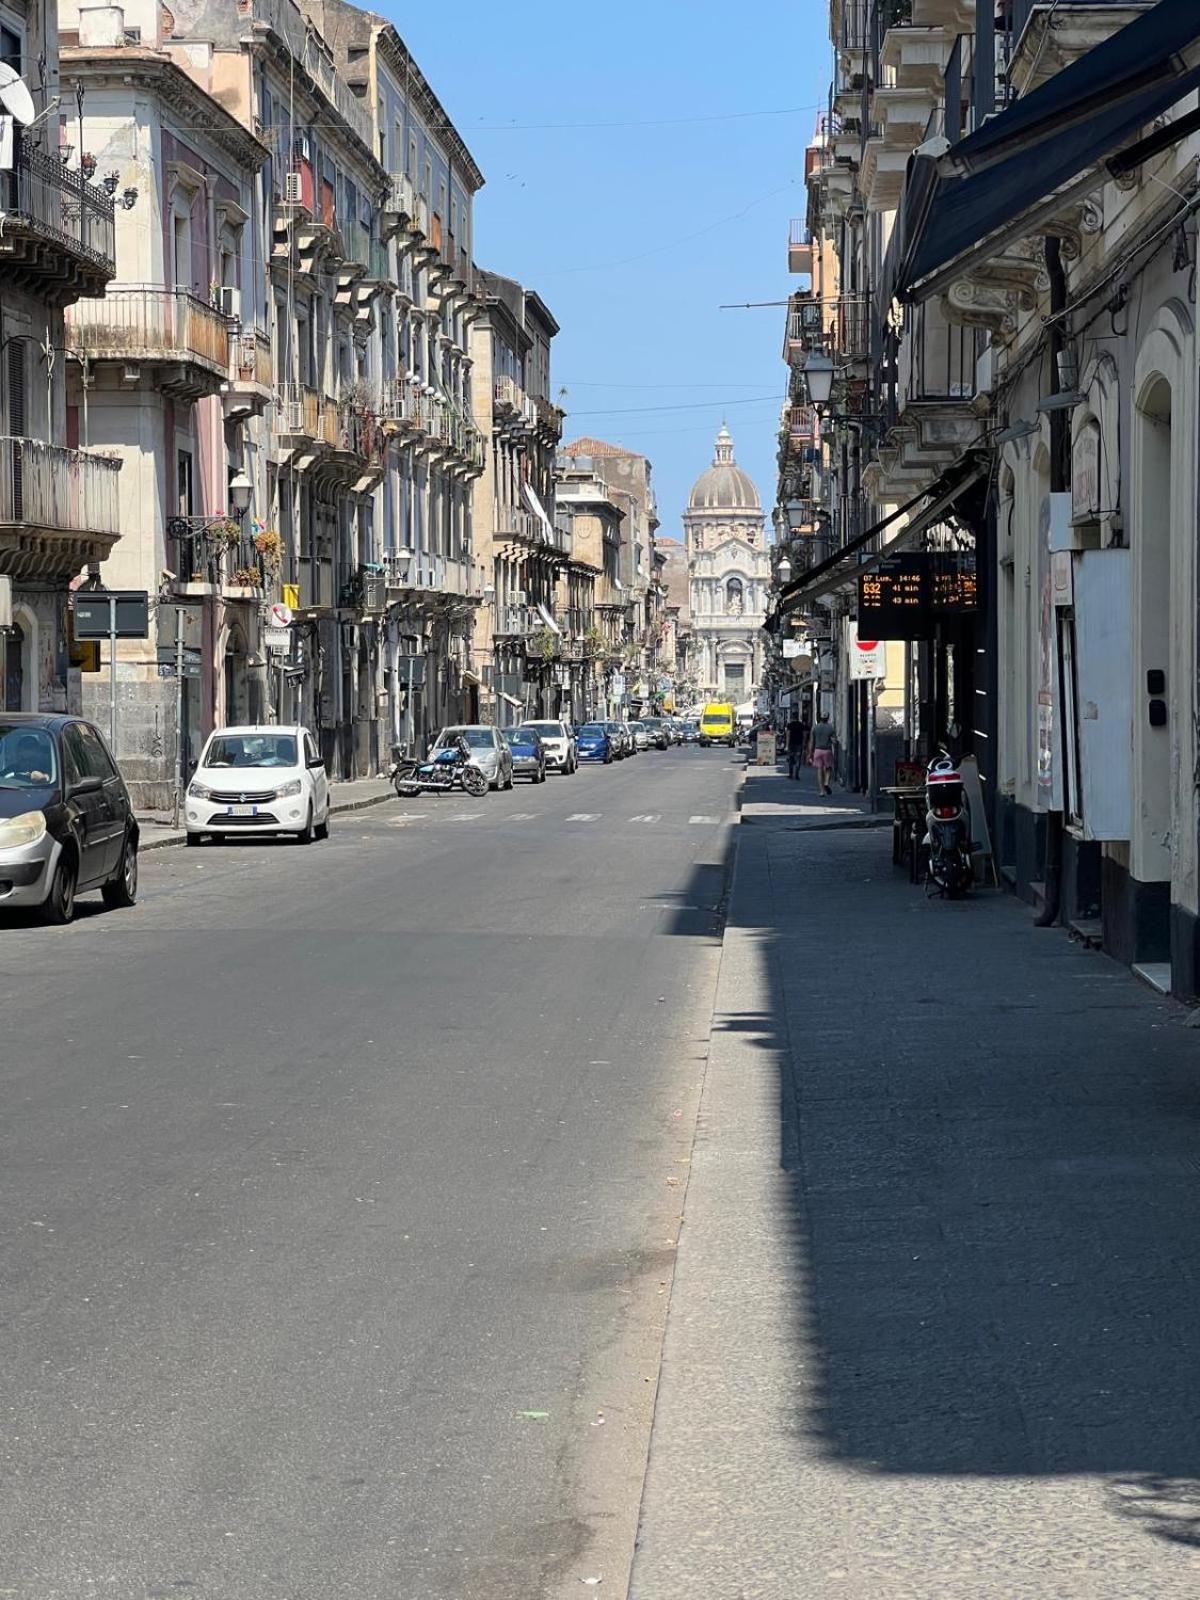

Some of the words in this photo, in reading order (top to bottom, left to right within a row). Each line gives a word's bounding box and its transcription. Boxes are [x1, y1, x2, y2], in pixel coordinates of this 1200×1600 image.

[863, 583, 881, 594] 632
[892, 584, 901, 592] 41
[904, 584, 919, 592] min
